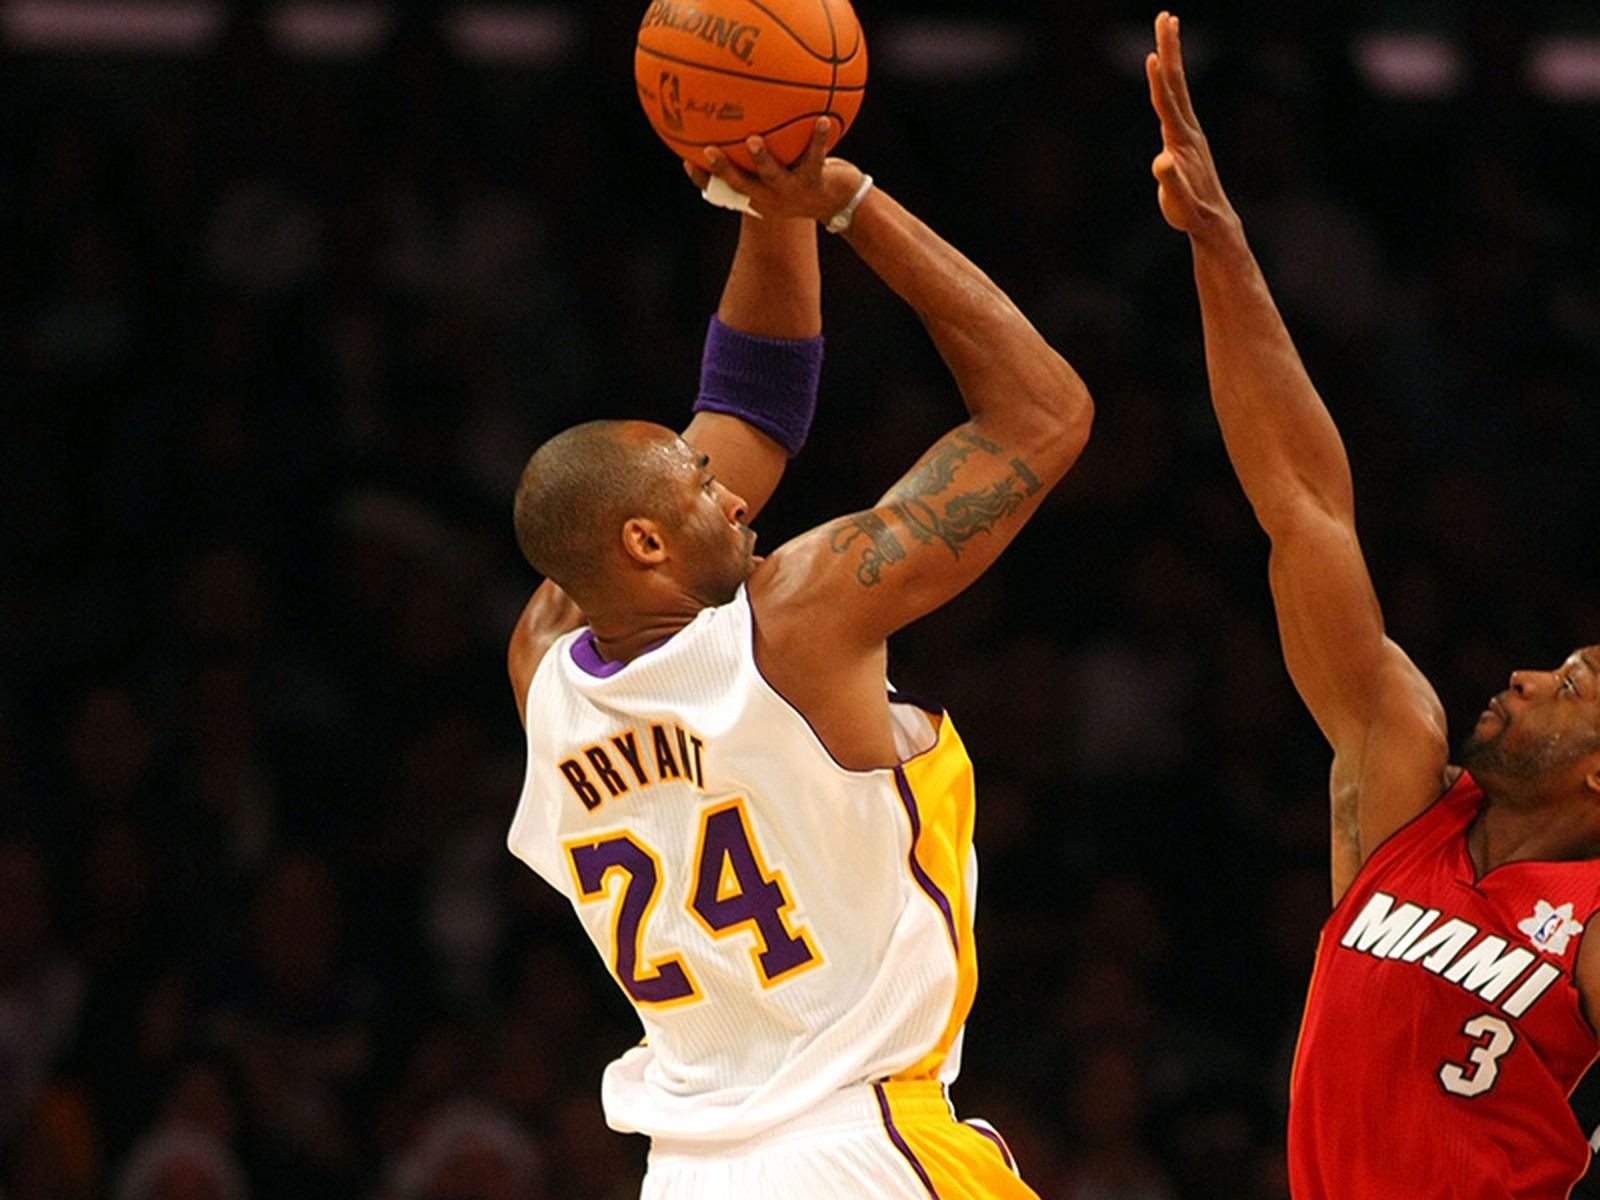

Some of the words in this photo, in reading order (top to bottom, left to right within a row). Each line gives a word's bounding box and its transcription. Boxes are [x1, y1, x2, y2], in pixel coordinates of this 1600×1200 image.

[562, 797, 824, 1009] 24
[1340, 890, 1562, 1019] MIAMI
[1438, 1012, 1516, 1098] 3
